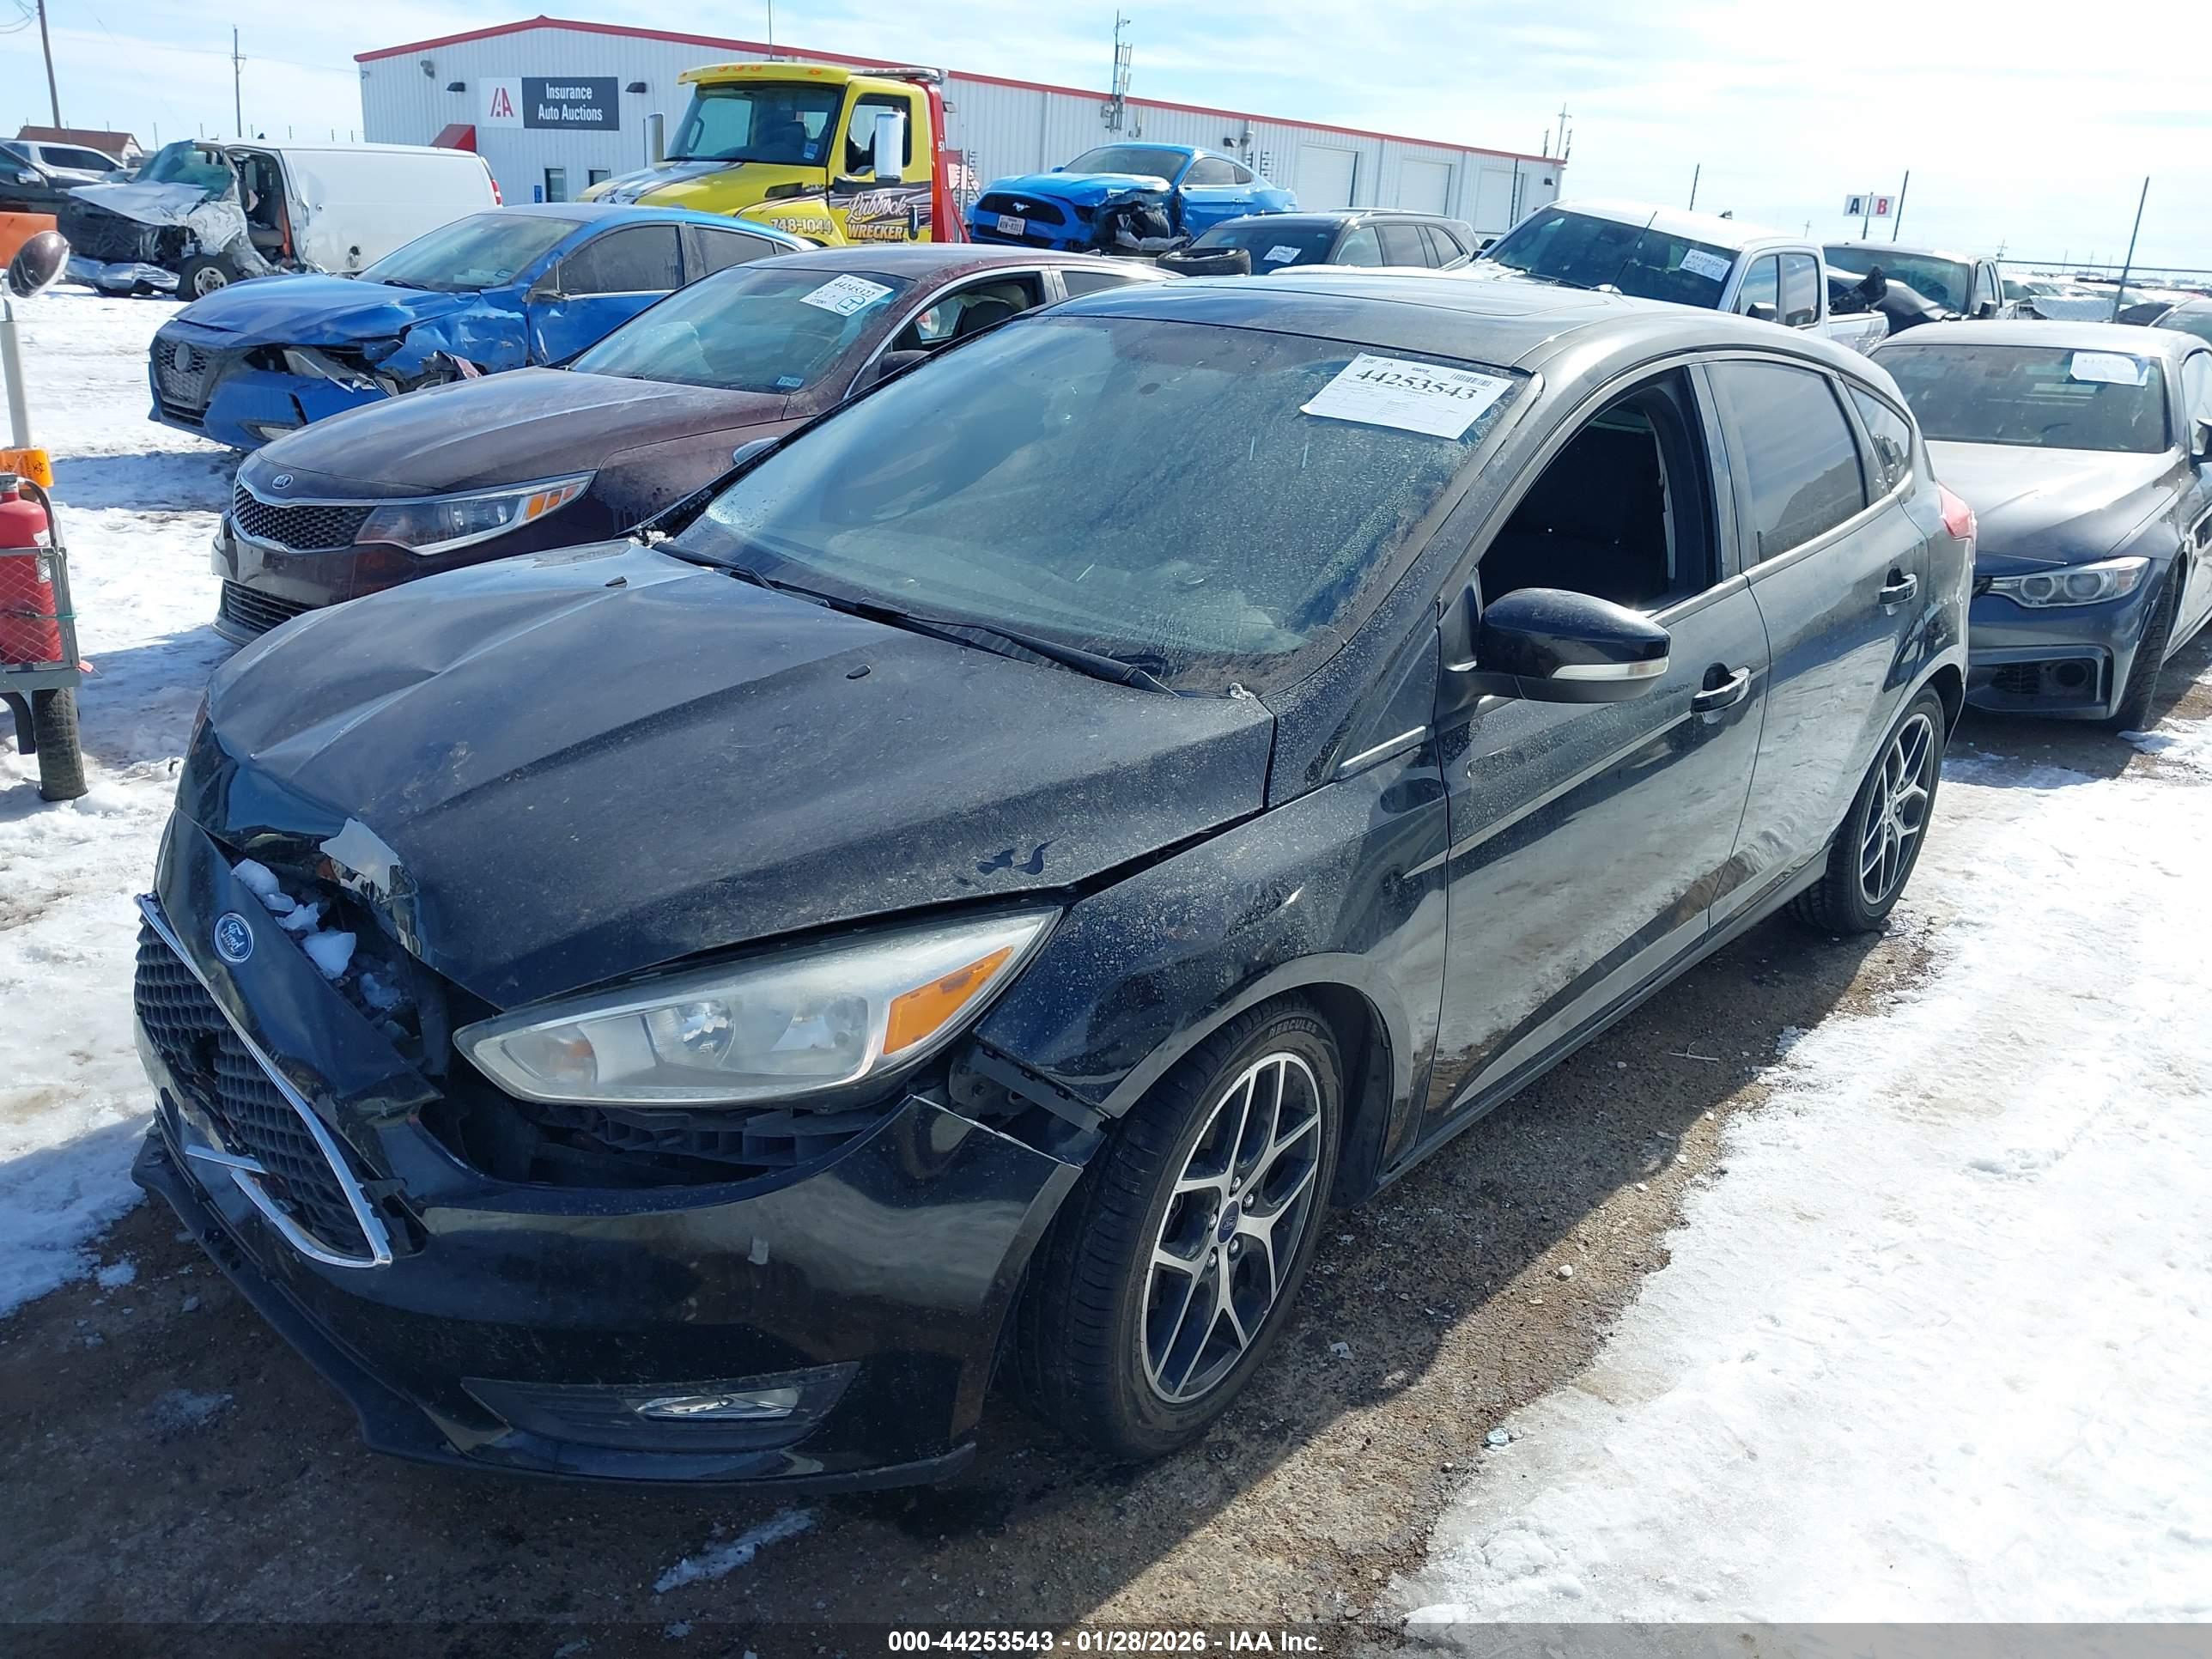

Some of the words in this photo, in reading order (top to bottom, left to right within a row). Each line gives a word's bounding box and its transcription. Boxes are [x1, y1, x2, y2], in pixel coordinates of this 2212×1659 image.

[545, 82, 592, 100] Insurance
[538, 103, 559, 121] Auto
[561, 104, 603, 122] Auctions
[1849, 198, 1860, 215] A
[1876, 198, 1888, 215] B
[769, 218, 832, 234] 748-1044
[848, 224, 903, 240] WRECKER
[1355, 369, 1478, 400] 44253543
[220, 921, 246, 954] Ford
[1267, 1018, 1318, 1040] HERCULES
